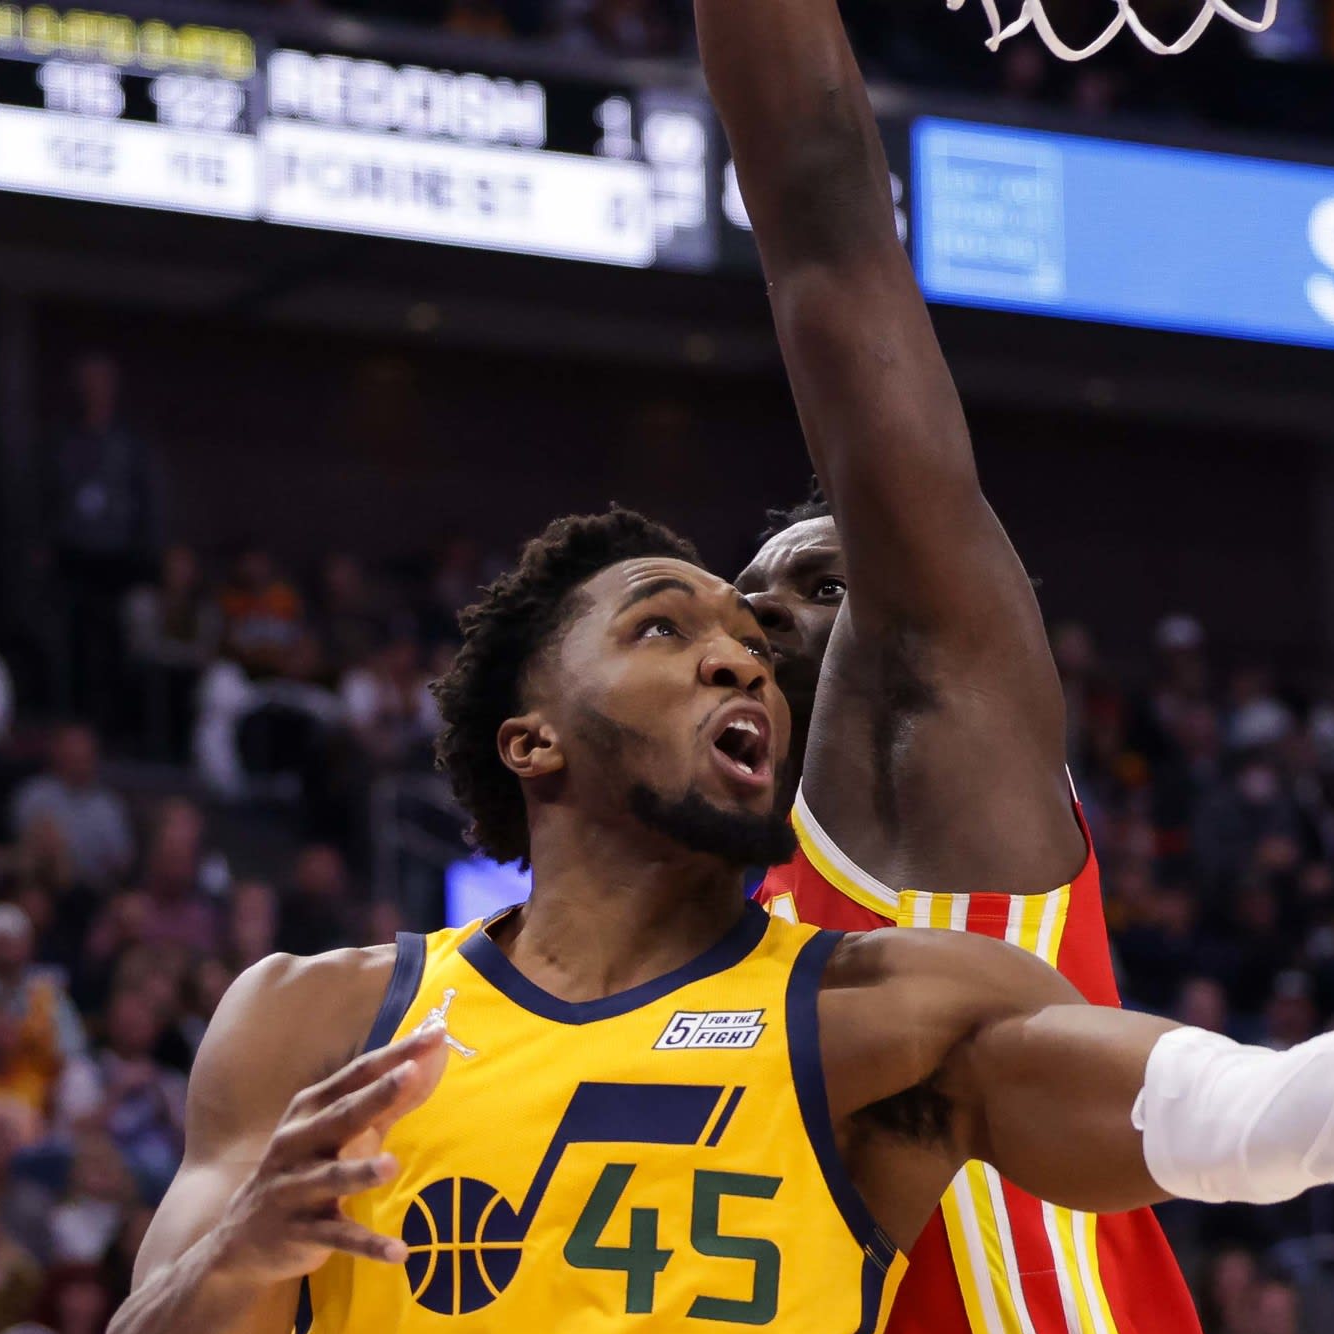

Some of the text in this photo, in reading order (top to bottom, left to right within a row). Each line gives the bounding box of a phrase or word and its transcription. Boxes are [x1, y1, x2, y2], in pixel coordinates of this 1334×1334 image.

[708, 1014, 753, 1025] FOR THE
[665, 1016, 698, 1045] 5
[695, 1030, 755, 1044] FIGHT
[563, 1162, 783, 1325] 45
